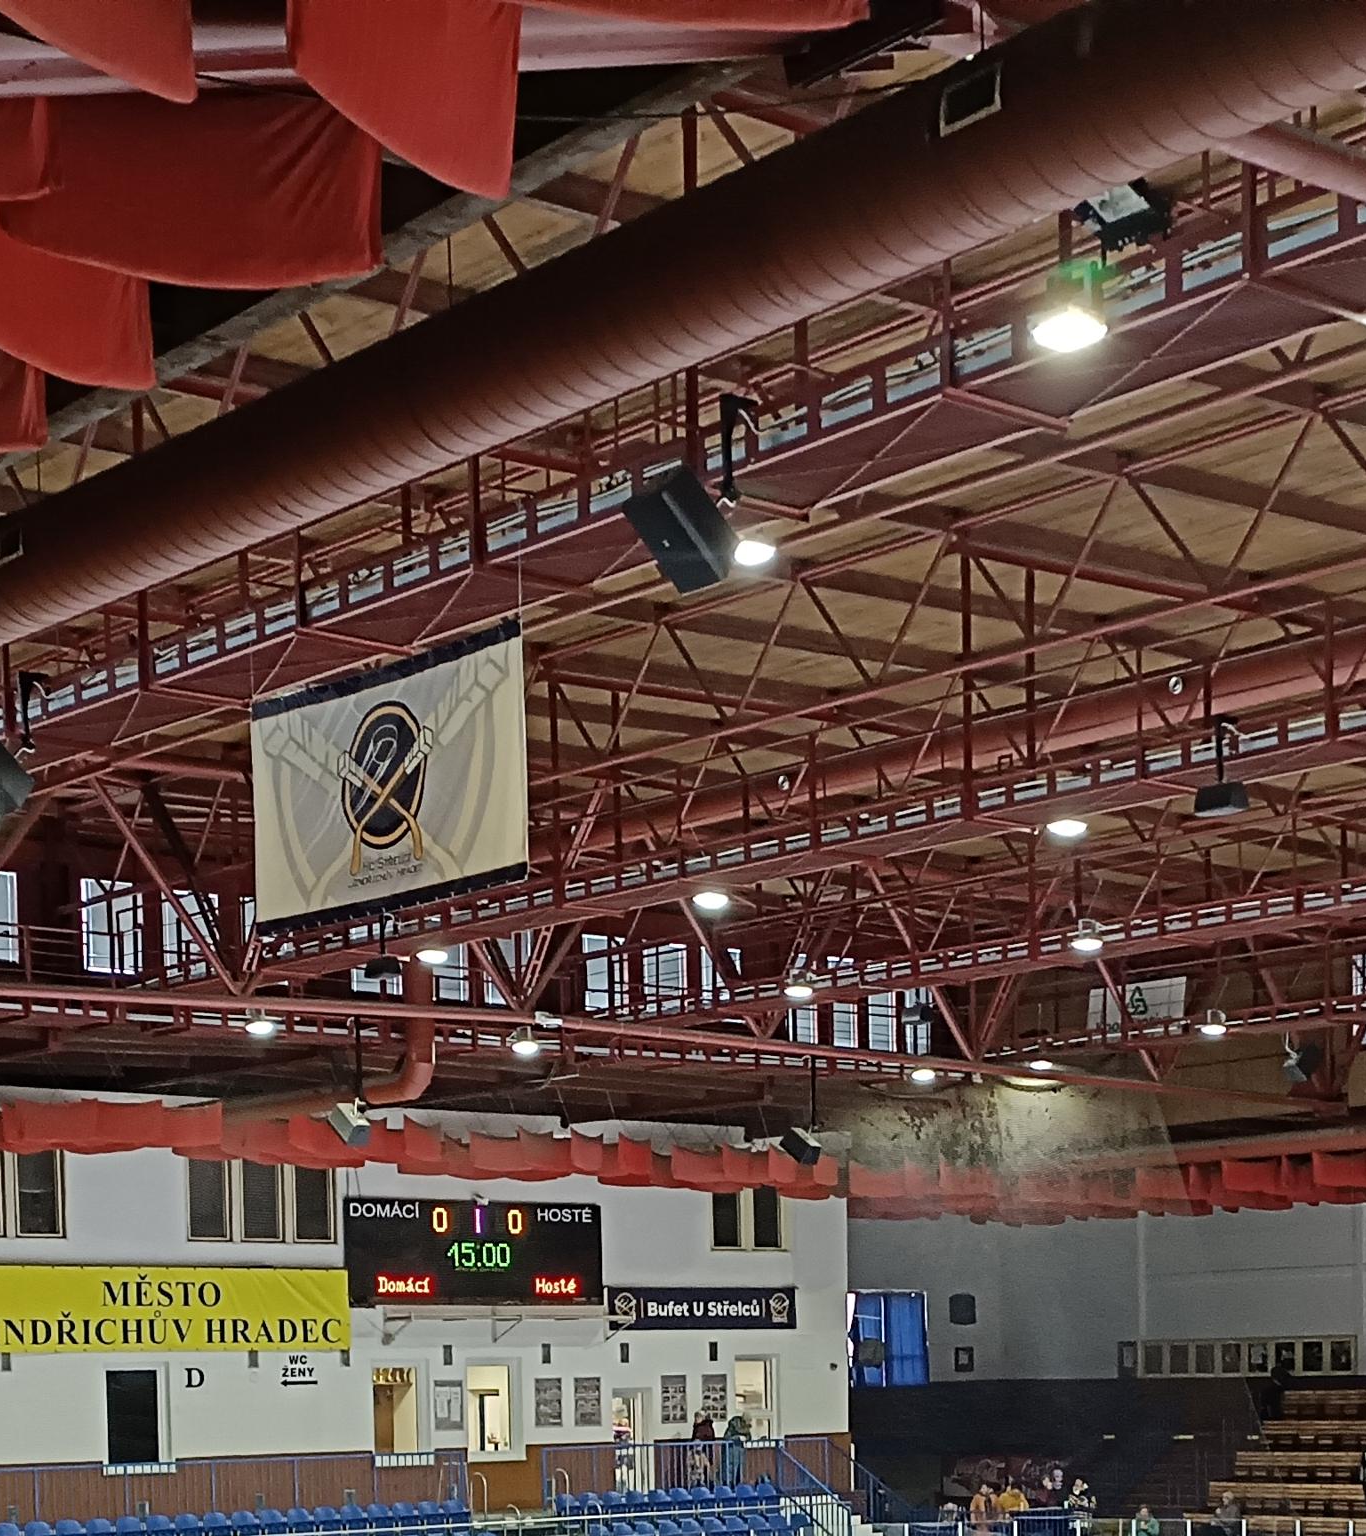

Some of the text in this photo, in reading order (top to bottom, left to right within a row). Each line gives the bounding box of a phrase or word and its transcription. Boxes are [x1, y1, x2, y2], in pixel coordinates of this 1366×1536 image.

[349, 1200, 419, 1219] DOMÁCÍ
[432, 1206, 448, 1233] 0
[507, 1209, 523, 1235] 0
[537, 1206, 593, 1223] HOSTÉ
[101, 1274, 222, 1307] MĚSTO
[377, 1275, 577, 1294] Domácí Hosté
[647, 1299, 761, 1317] Bufet U Střelců
[206, 1318, 342, 1345] HRADEC
[288, 1354, 308, 1365] WC
[184, 1367, 205, 1388] D
[281, 1365, 315, 1378] ŽENY
